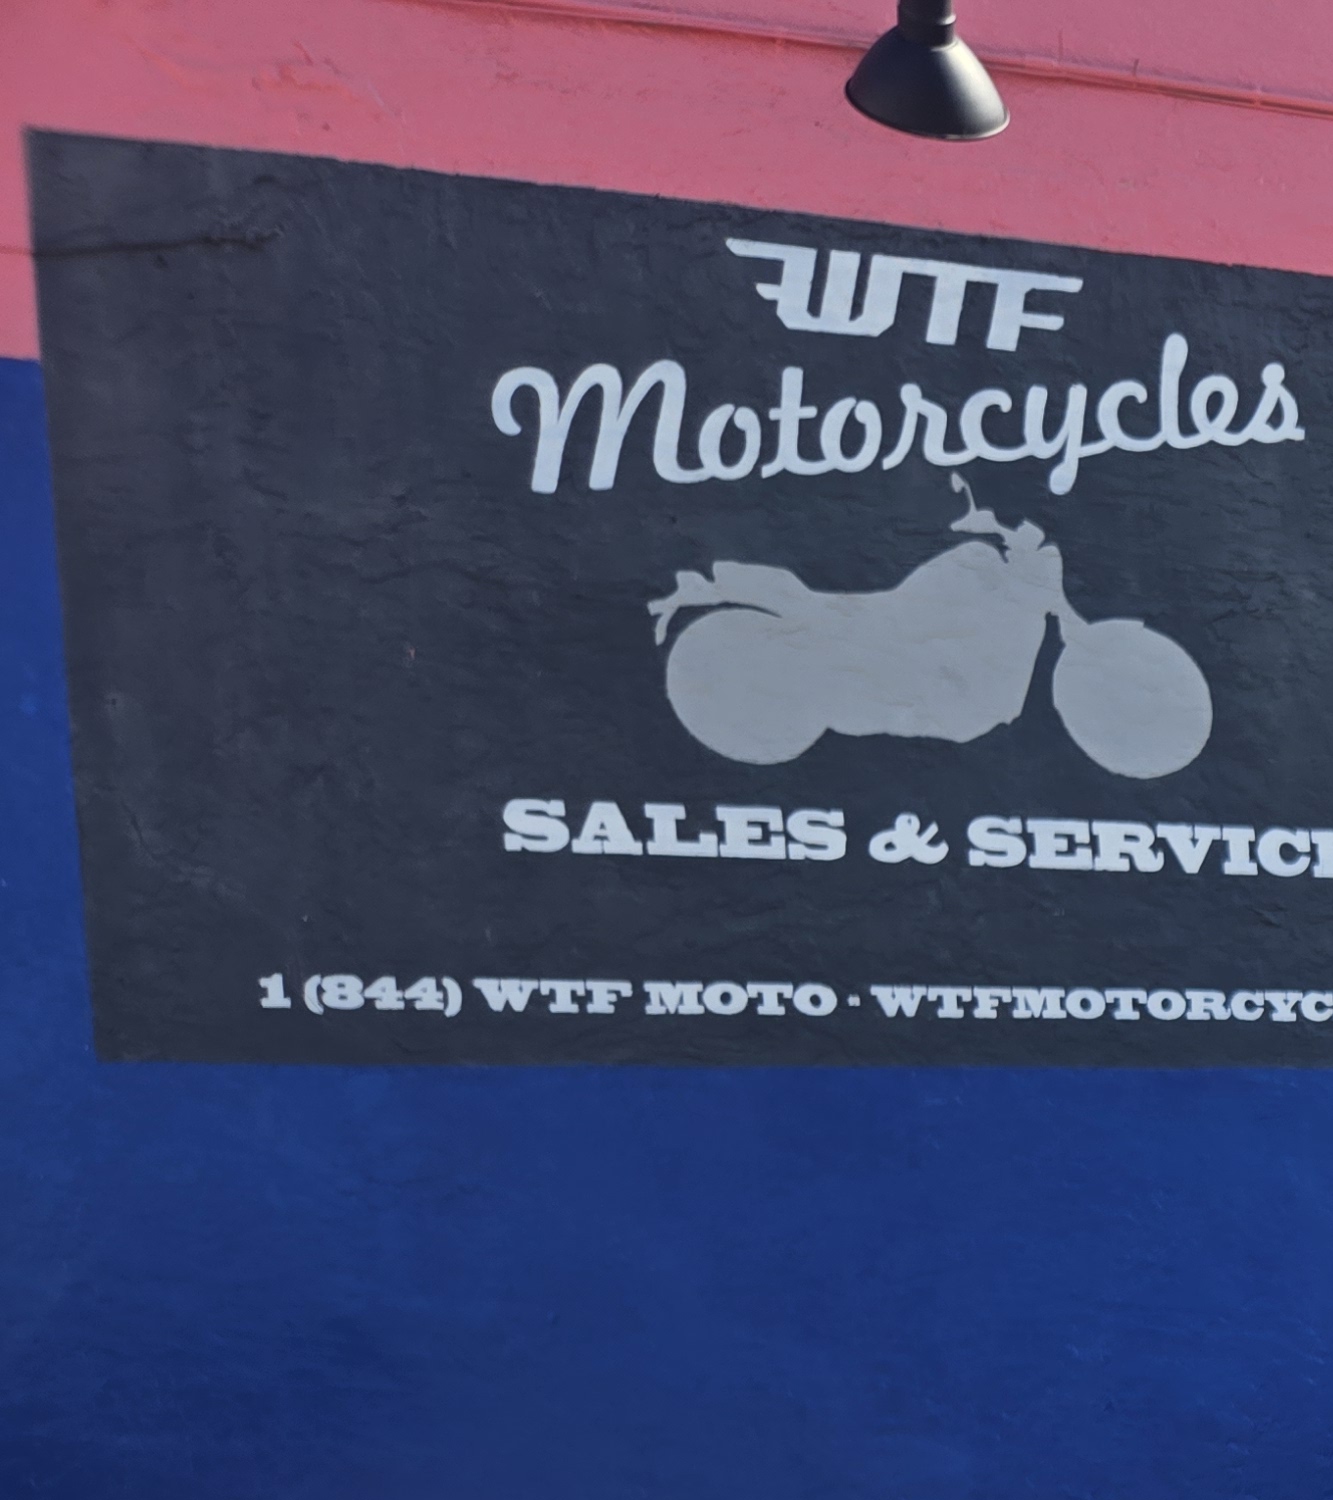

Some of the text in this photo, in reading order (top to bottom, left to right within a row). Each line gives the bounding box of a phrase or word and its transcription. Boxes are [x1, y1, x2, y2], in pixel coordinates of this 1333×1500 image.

[726, 238, 1083, 352] WTF
[491, 333, 1306, 496] Motorcycles
[502, 798, 847, 861] SALES
[868, 813, 949, 865] &
[259, 973, 292, 1008] 1
[303, 974, 463, 1018] (844)
[472, 978, 633, 1014] WTF
[643, 981, 838, 1016] MOTO
